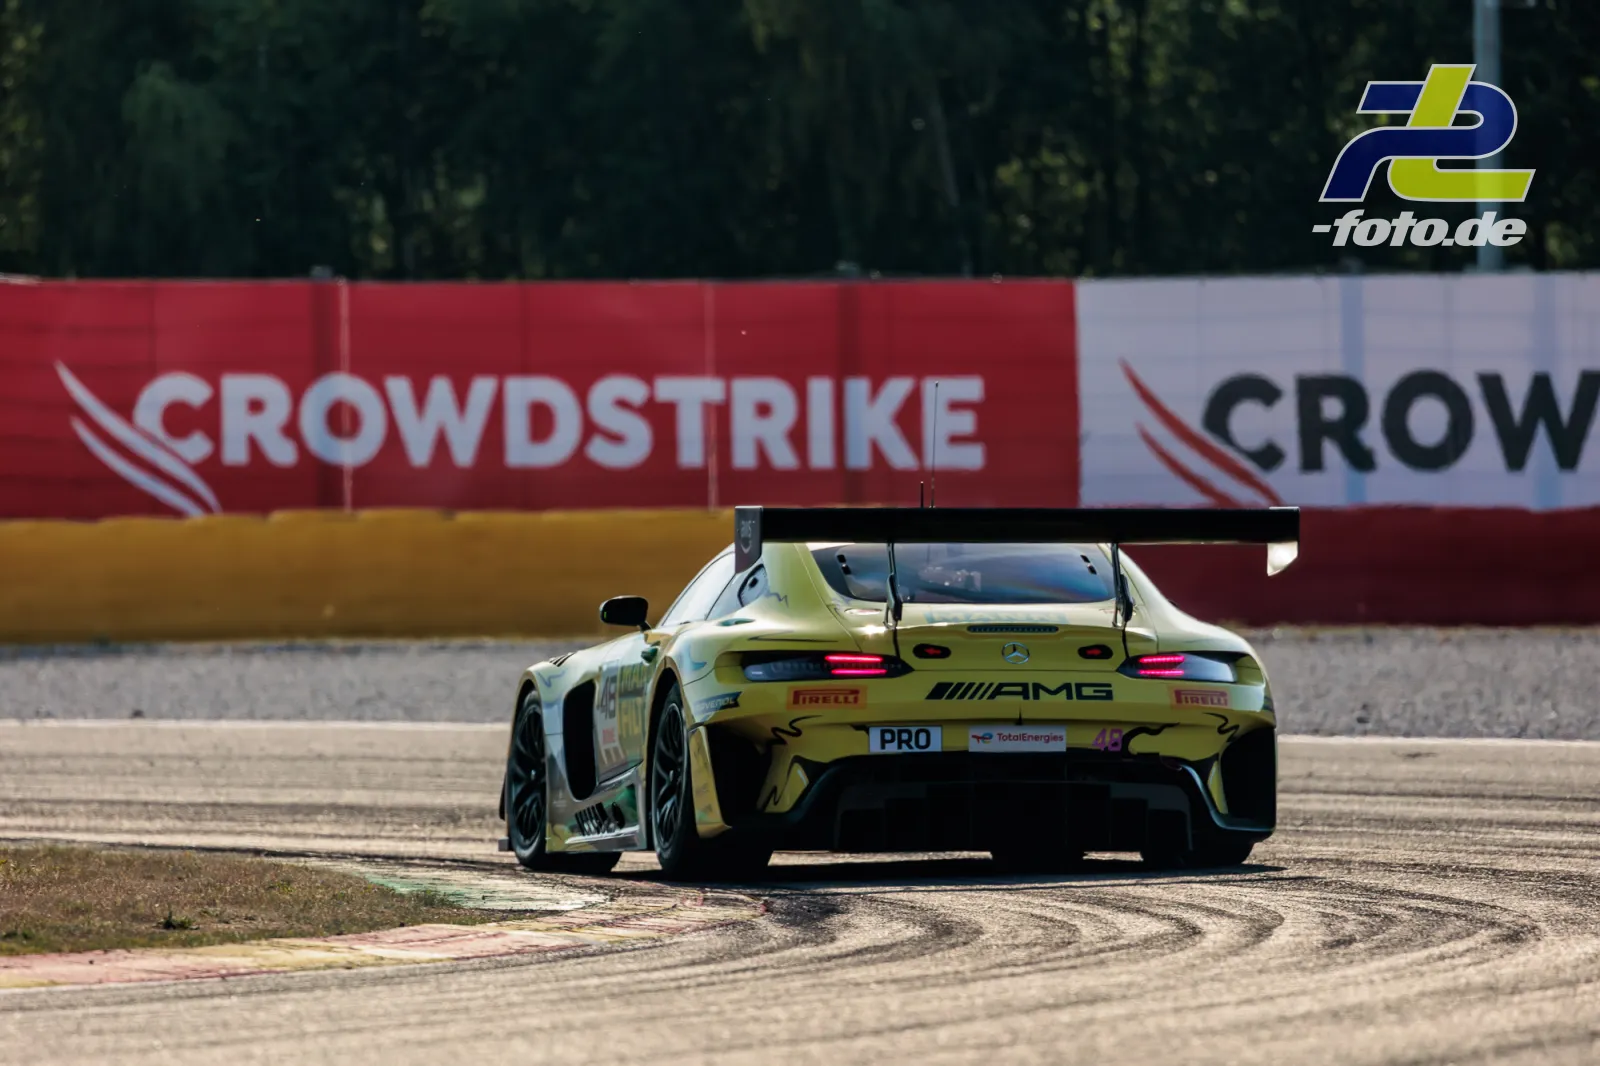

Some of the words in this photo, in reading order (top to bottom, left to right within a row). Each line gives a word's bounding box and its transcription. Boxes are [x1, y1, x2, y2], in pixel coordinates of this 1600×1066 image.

[133, 370, 985, 472] CROWDSTRIKE
[791, 688, 860, 705] PIRELLI
[1174, 689, 1228, 706] PIRELLI
[880, 728, 931, 750] PRO
[997, 732, 1064, 745] TotalEnergies
[1092, 728, 1124, 751] 48
